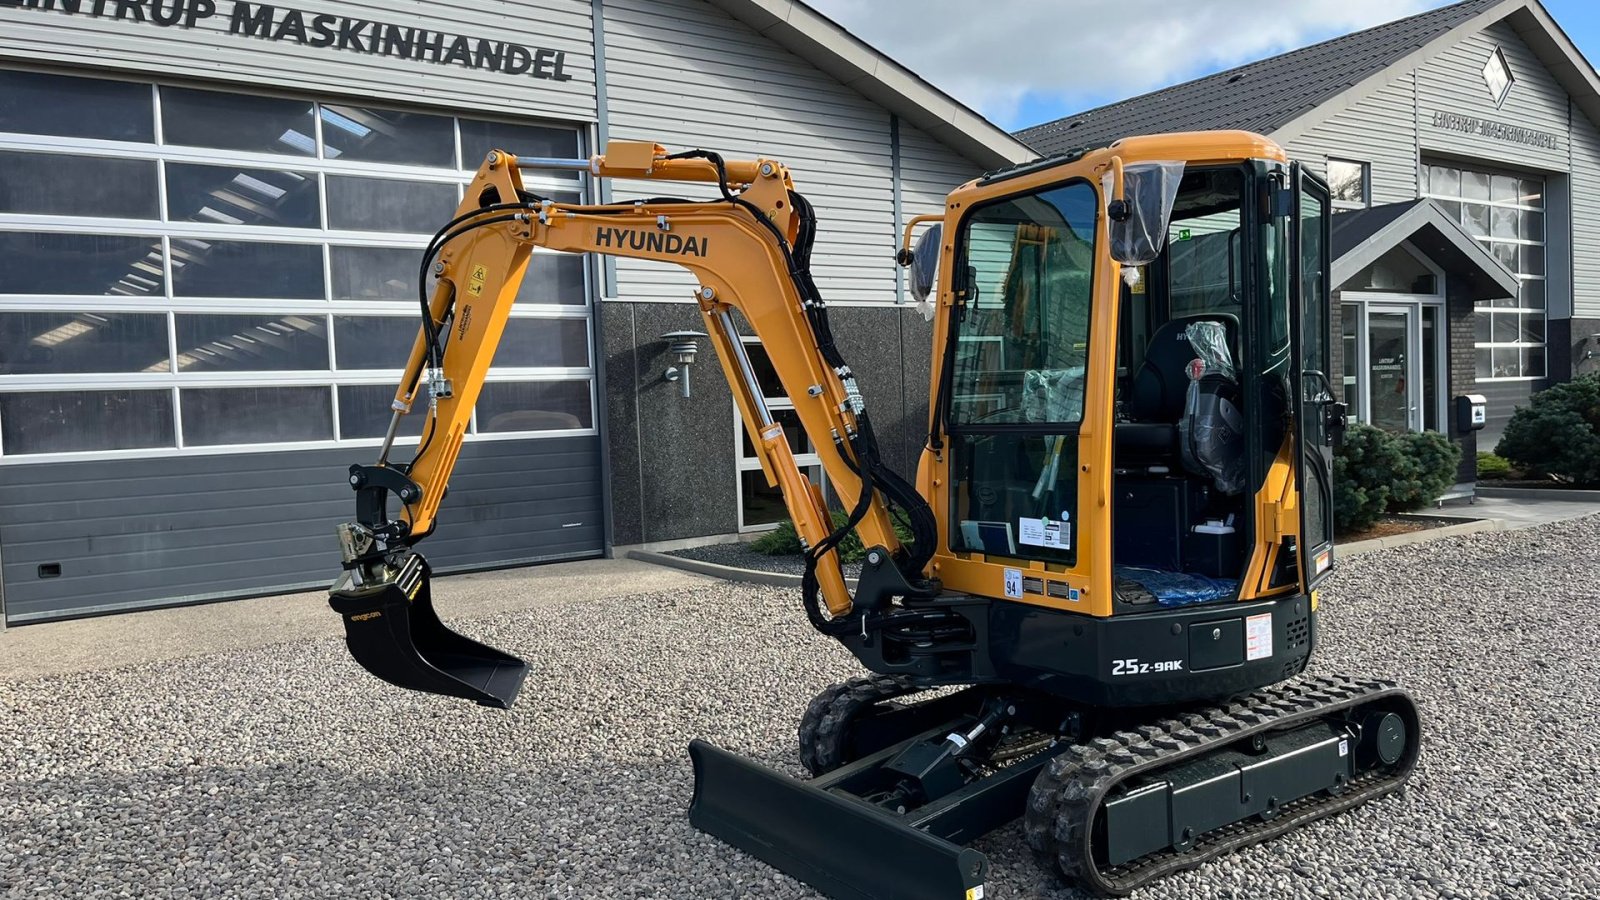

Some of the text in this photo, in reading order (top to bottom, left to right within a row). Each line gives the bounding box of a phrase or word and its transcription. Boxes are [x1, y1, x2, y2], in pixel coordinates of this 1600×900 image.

[0, 0, 572, 81] TRUP MASKINHANDEL
[596, 226, 708, 257] HYUNDAI
[1006, 581, 1017, 595] 94
